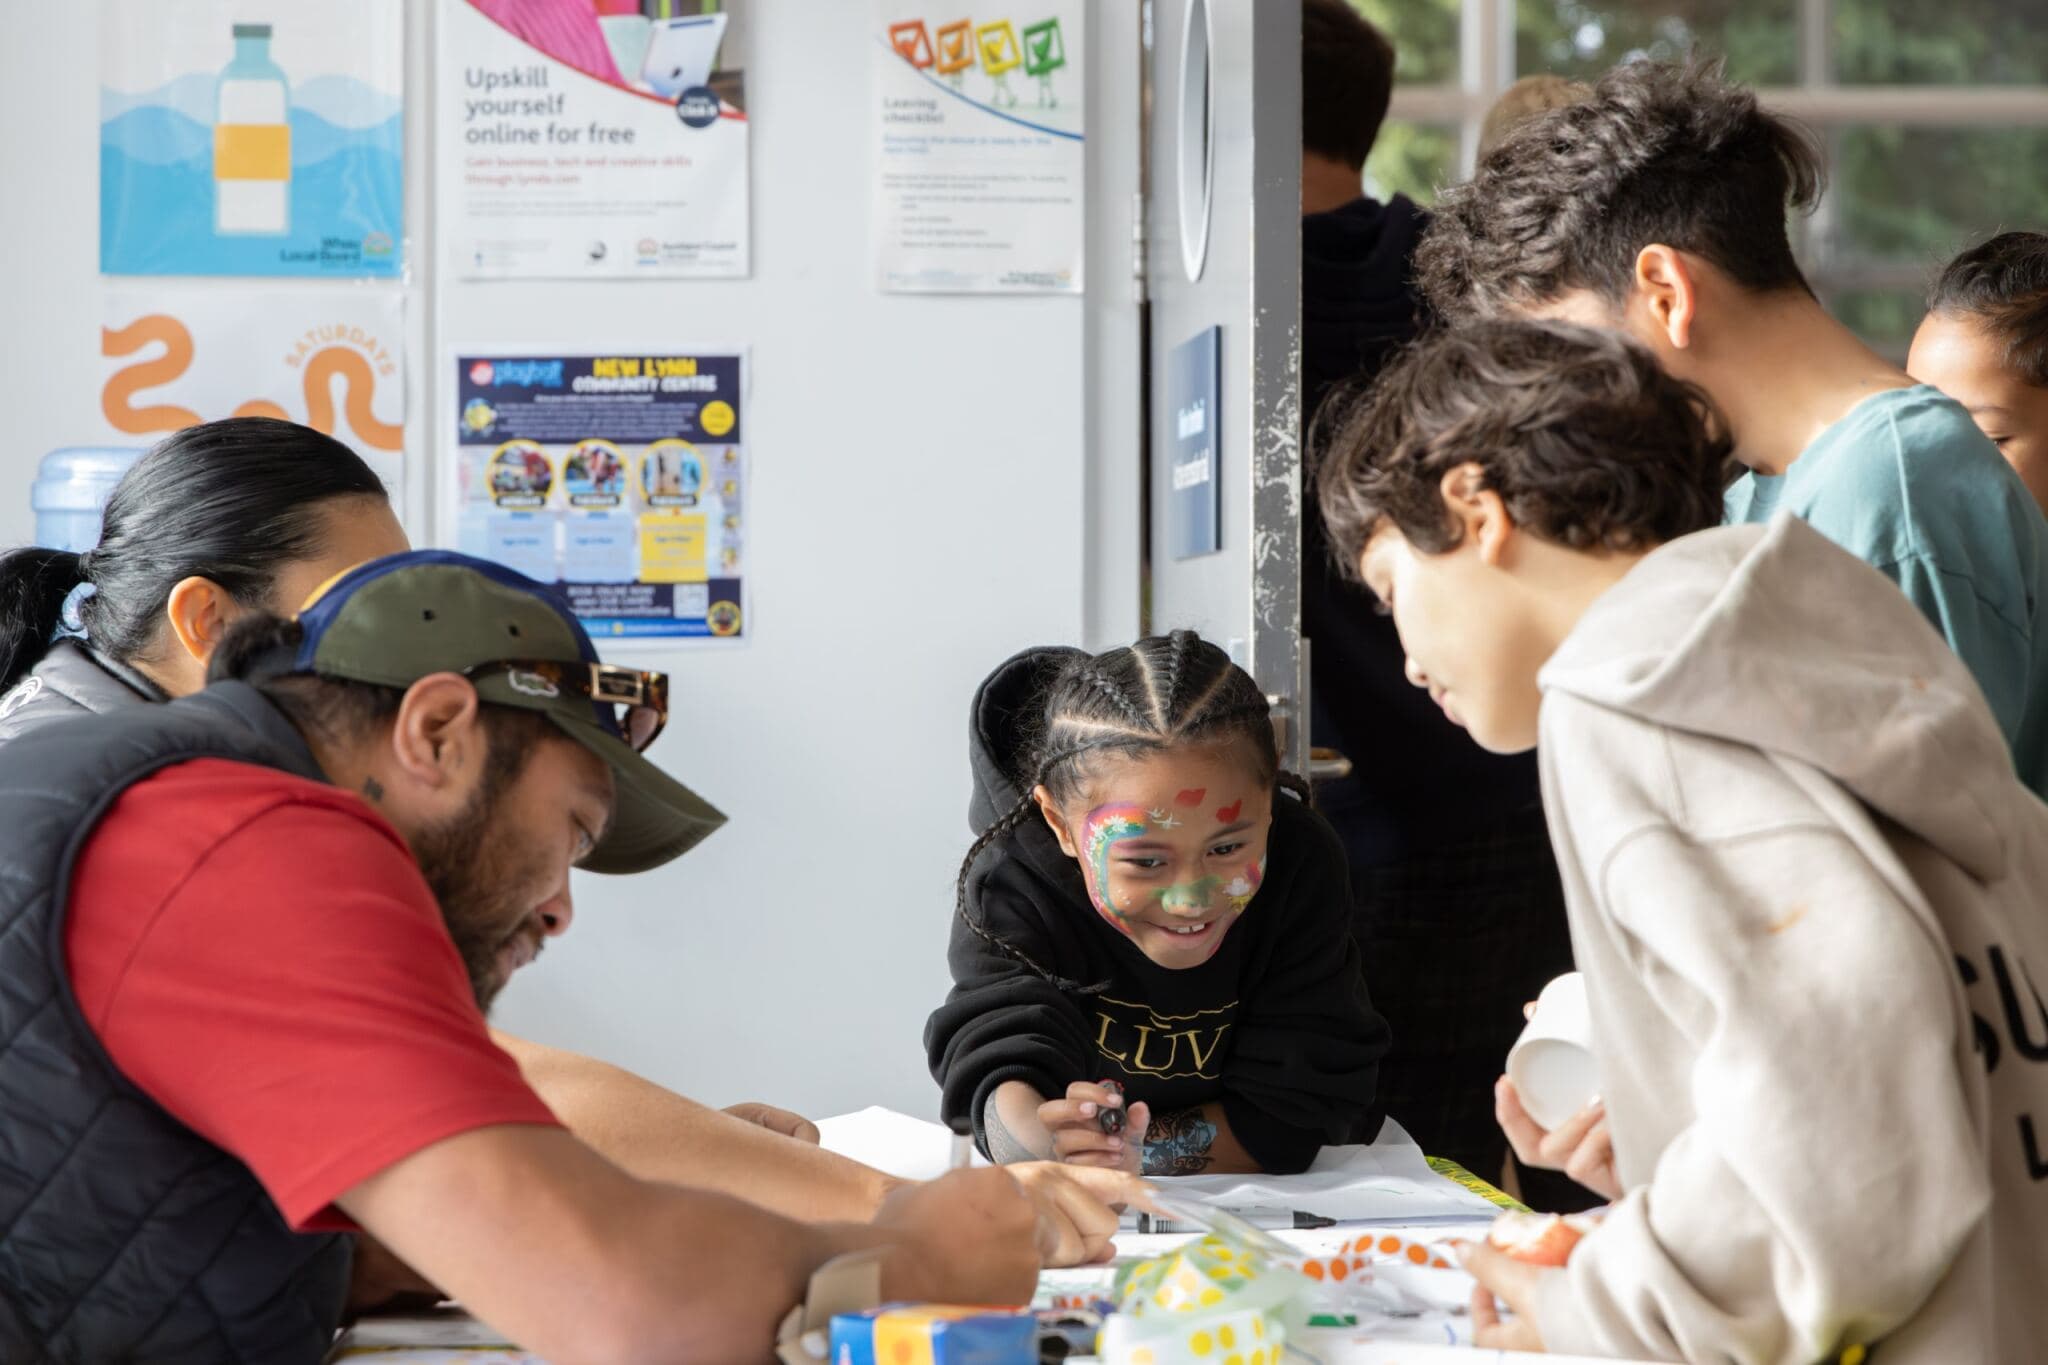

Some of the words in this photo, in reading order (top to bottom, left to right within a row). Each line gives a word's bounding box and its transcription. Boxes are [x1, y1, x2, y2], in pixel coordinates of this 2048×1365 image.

[465, 66, 549, 95] Upskill
[465, 93, 565, 122] yourself
[465, 122, 541, 146] online
[547, 122, 580, 145] for
[588, 121, 636, 145] free
[283, 321, 395, 377] SATURDAYS
[592, 357, 640, 376] NEW
